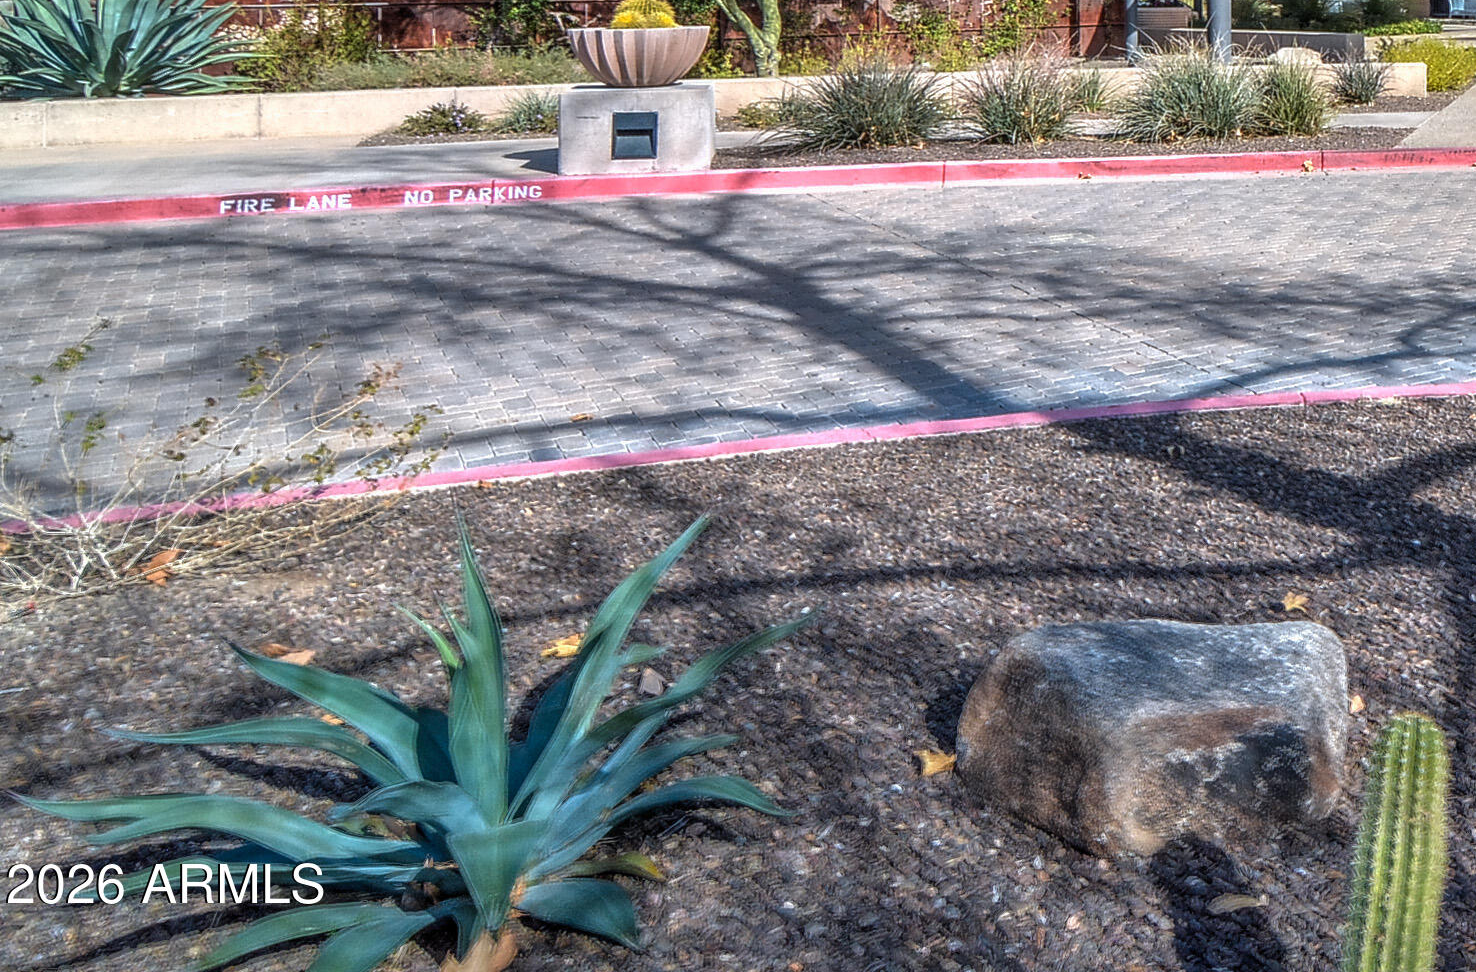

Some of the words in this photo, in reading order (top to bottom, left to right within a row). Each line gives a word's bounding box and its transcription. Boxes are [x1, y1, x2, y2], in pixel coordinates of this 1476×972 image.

[219, 197, 276, 214] FIRE
[288, 193, 353, 211] LANE
[404, 189, 434, 206] NO
[449, 185, 543, 204] PARKING
